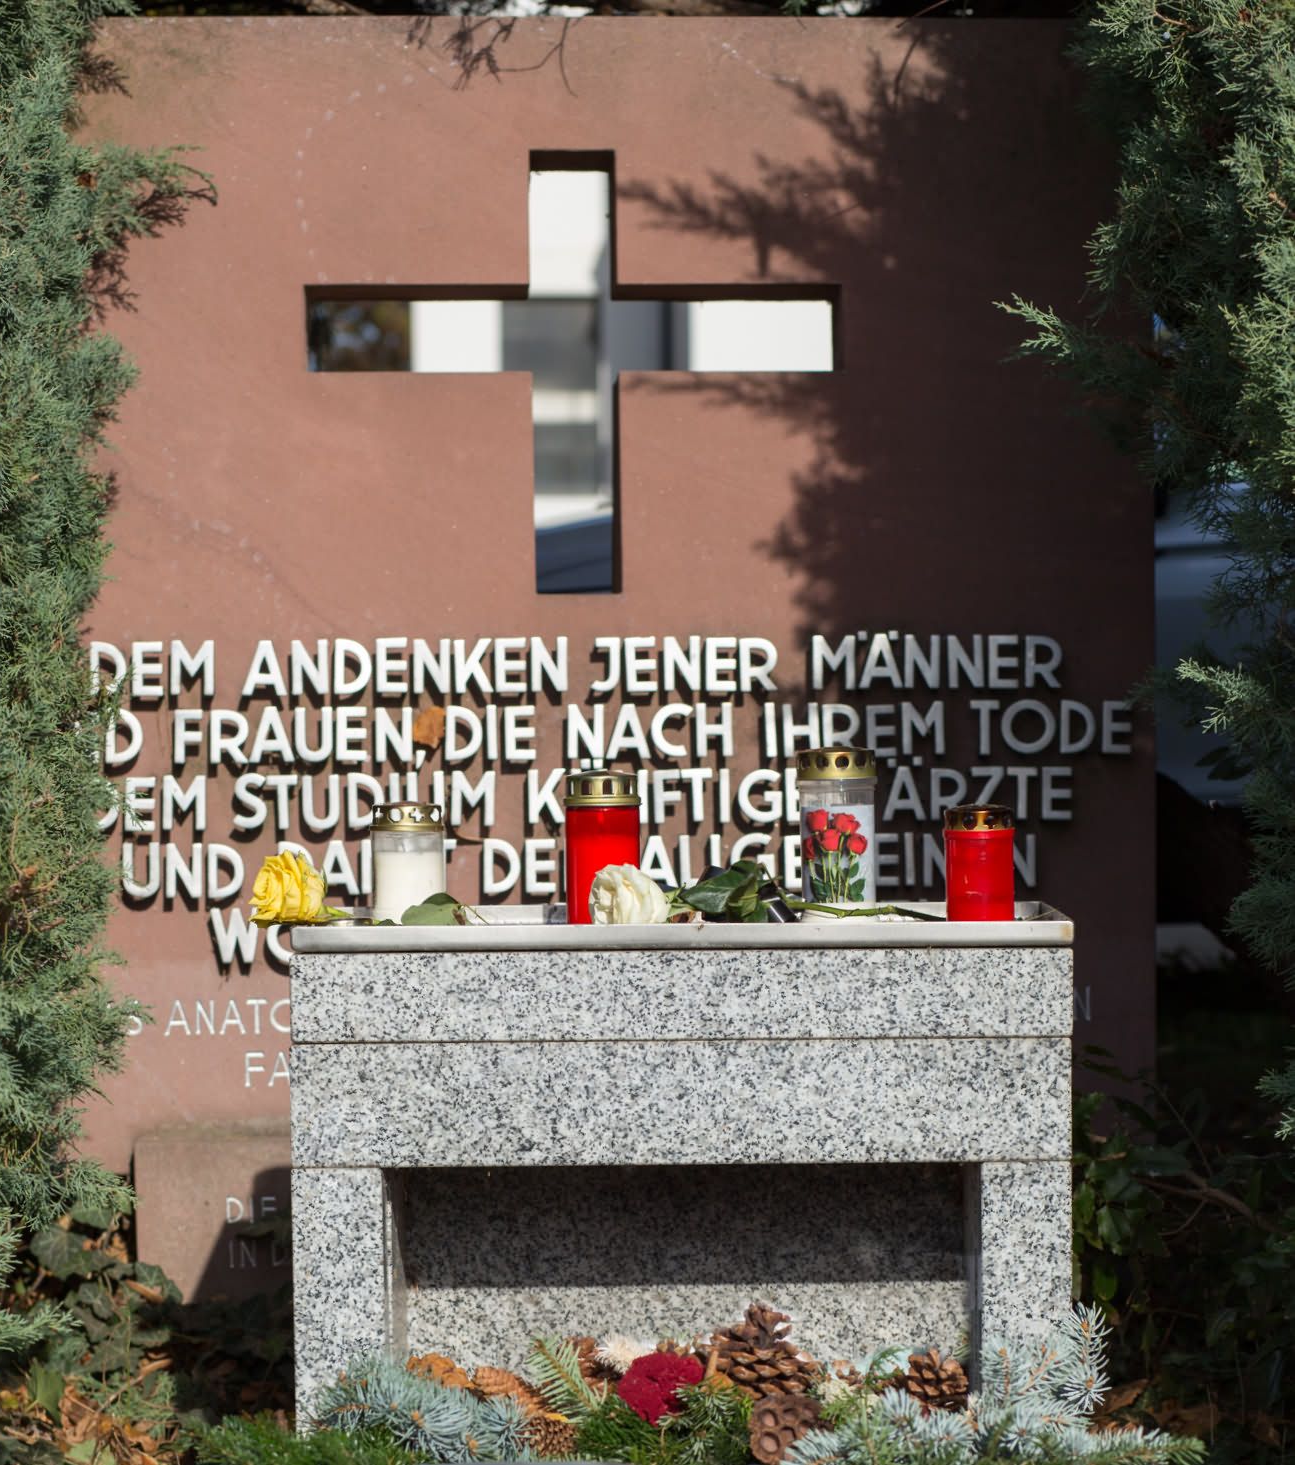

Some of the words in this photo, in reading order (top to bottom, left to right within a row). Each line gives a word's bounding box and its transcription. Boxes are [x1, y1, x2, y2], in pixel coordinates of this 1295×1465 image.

[90, 639, 215, 697] DEM
[241, 636, 568, 697] ANDENKEN
[590, 635, 779, 693] JENER
[812, 630, 1063, 691] MÄNNER
[174, 704, 428, 770] FRAUEN,
[444, 704, 537, 762] DIE
[567, 702, 734, 760] NACH
[764, 701, 946, 758] IHREM
[969, 699, 1133, 755] TODE
[882, 756, 1073, 822] ÄRZTE
[121, 841, 246, 899] UND
[483, 837, 566, 895] DE
